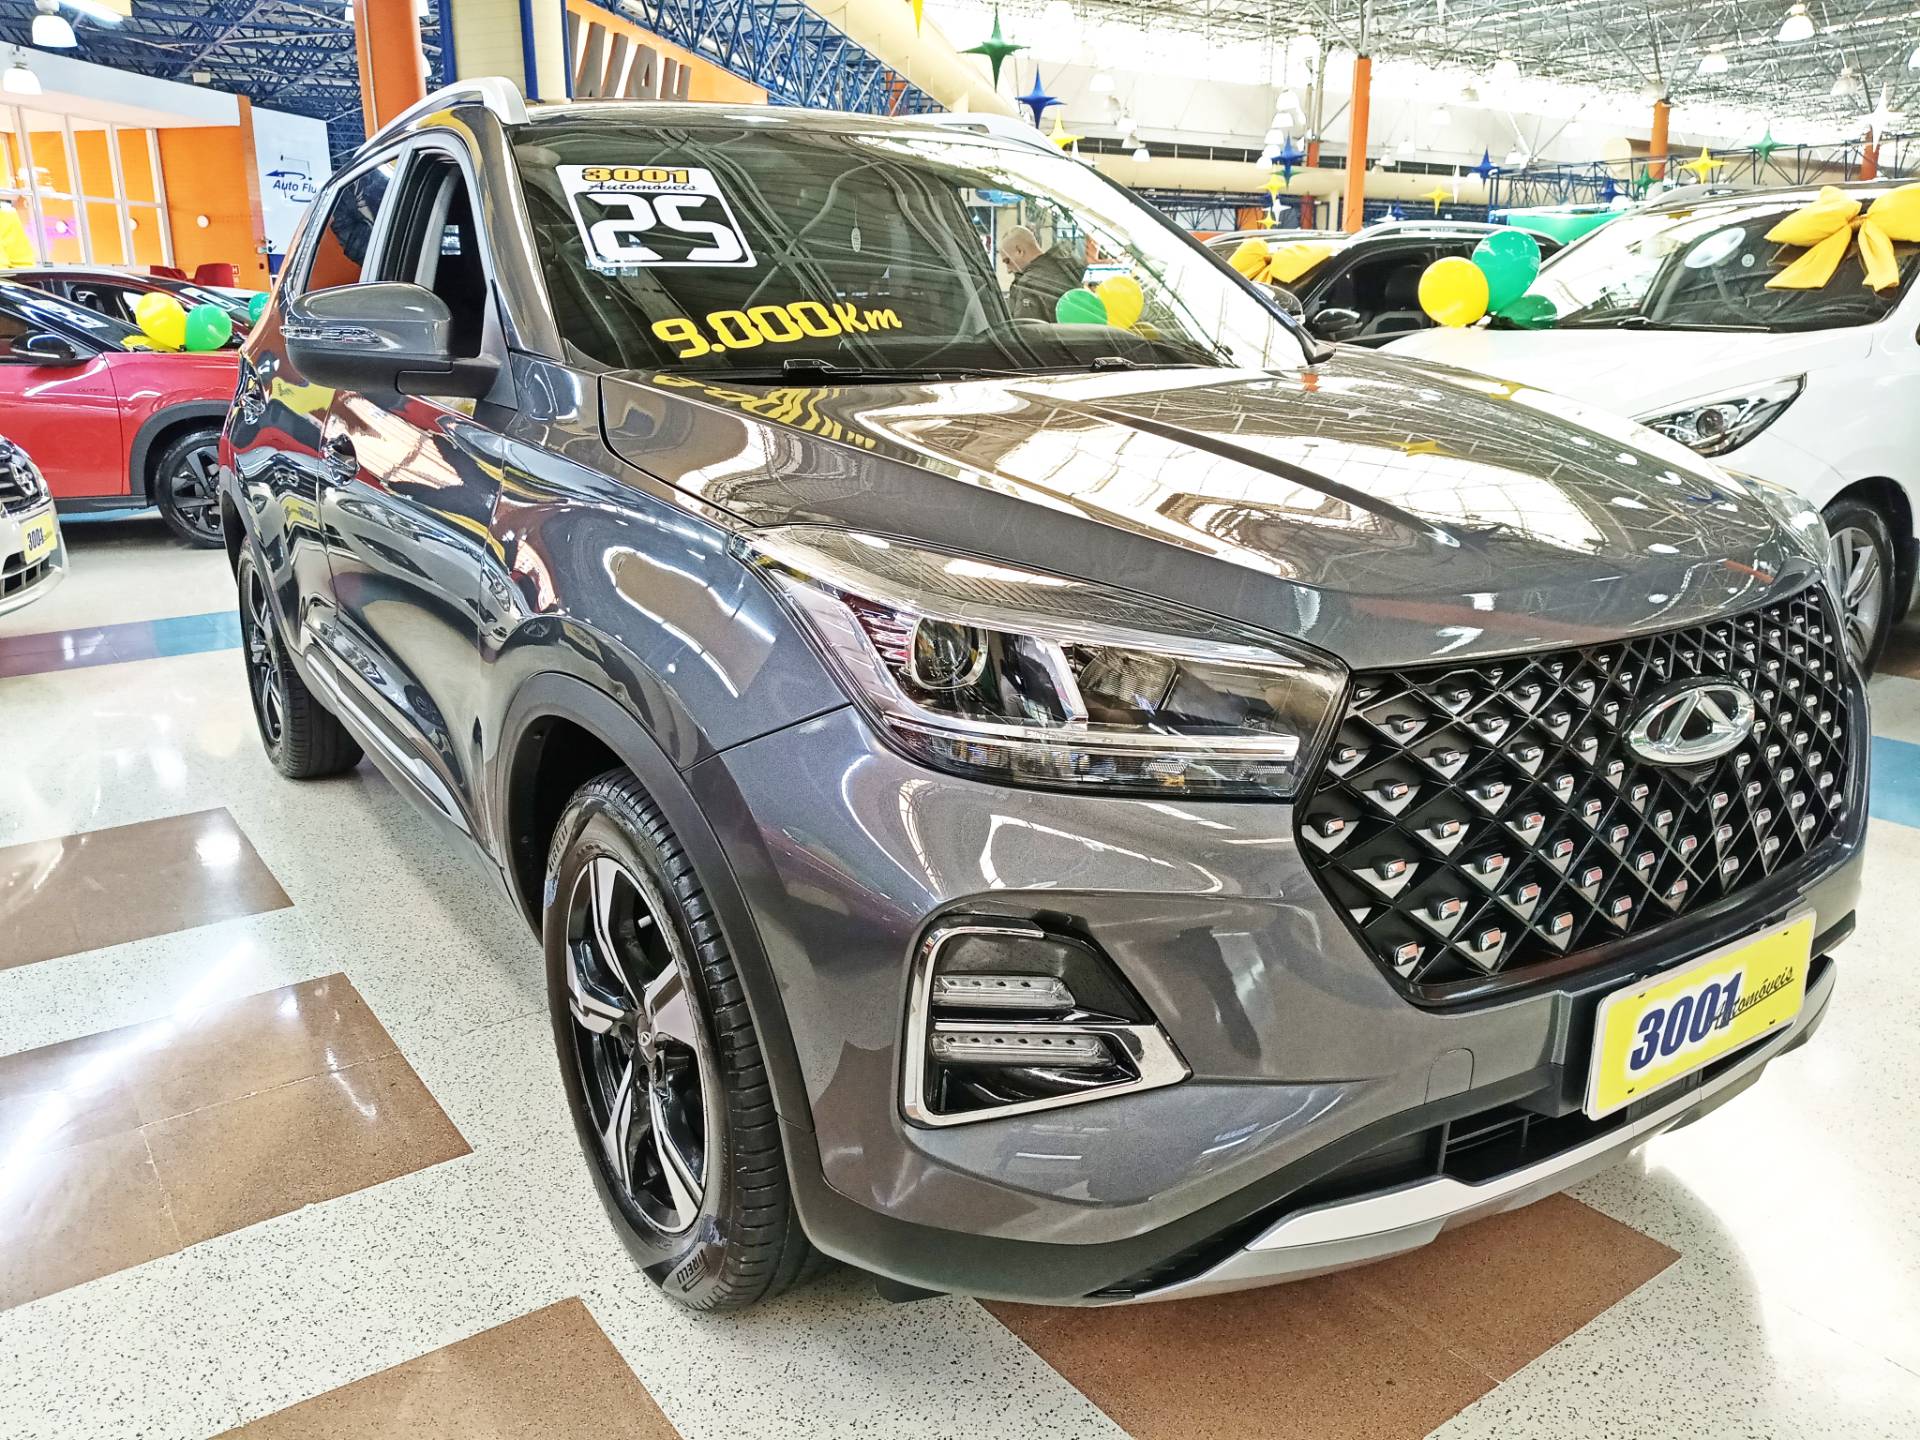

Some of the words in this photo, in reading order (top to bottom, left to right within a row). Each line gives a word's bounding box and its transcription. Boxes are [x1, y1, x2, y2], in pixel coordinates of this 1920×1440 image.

[273, 180, 298, 191] Auto
[582, 167, 689, 184] 3001
[585, 193, 743, 262] 25
[1629, 972, 1742, 1071] 3001
